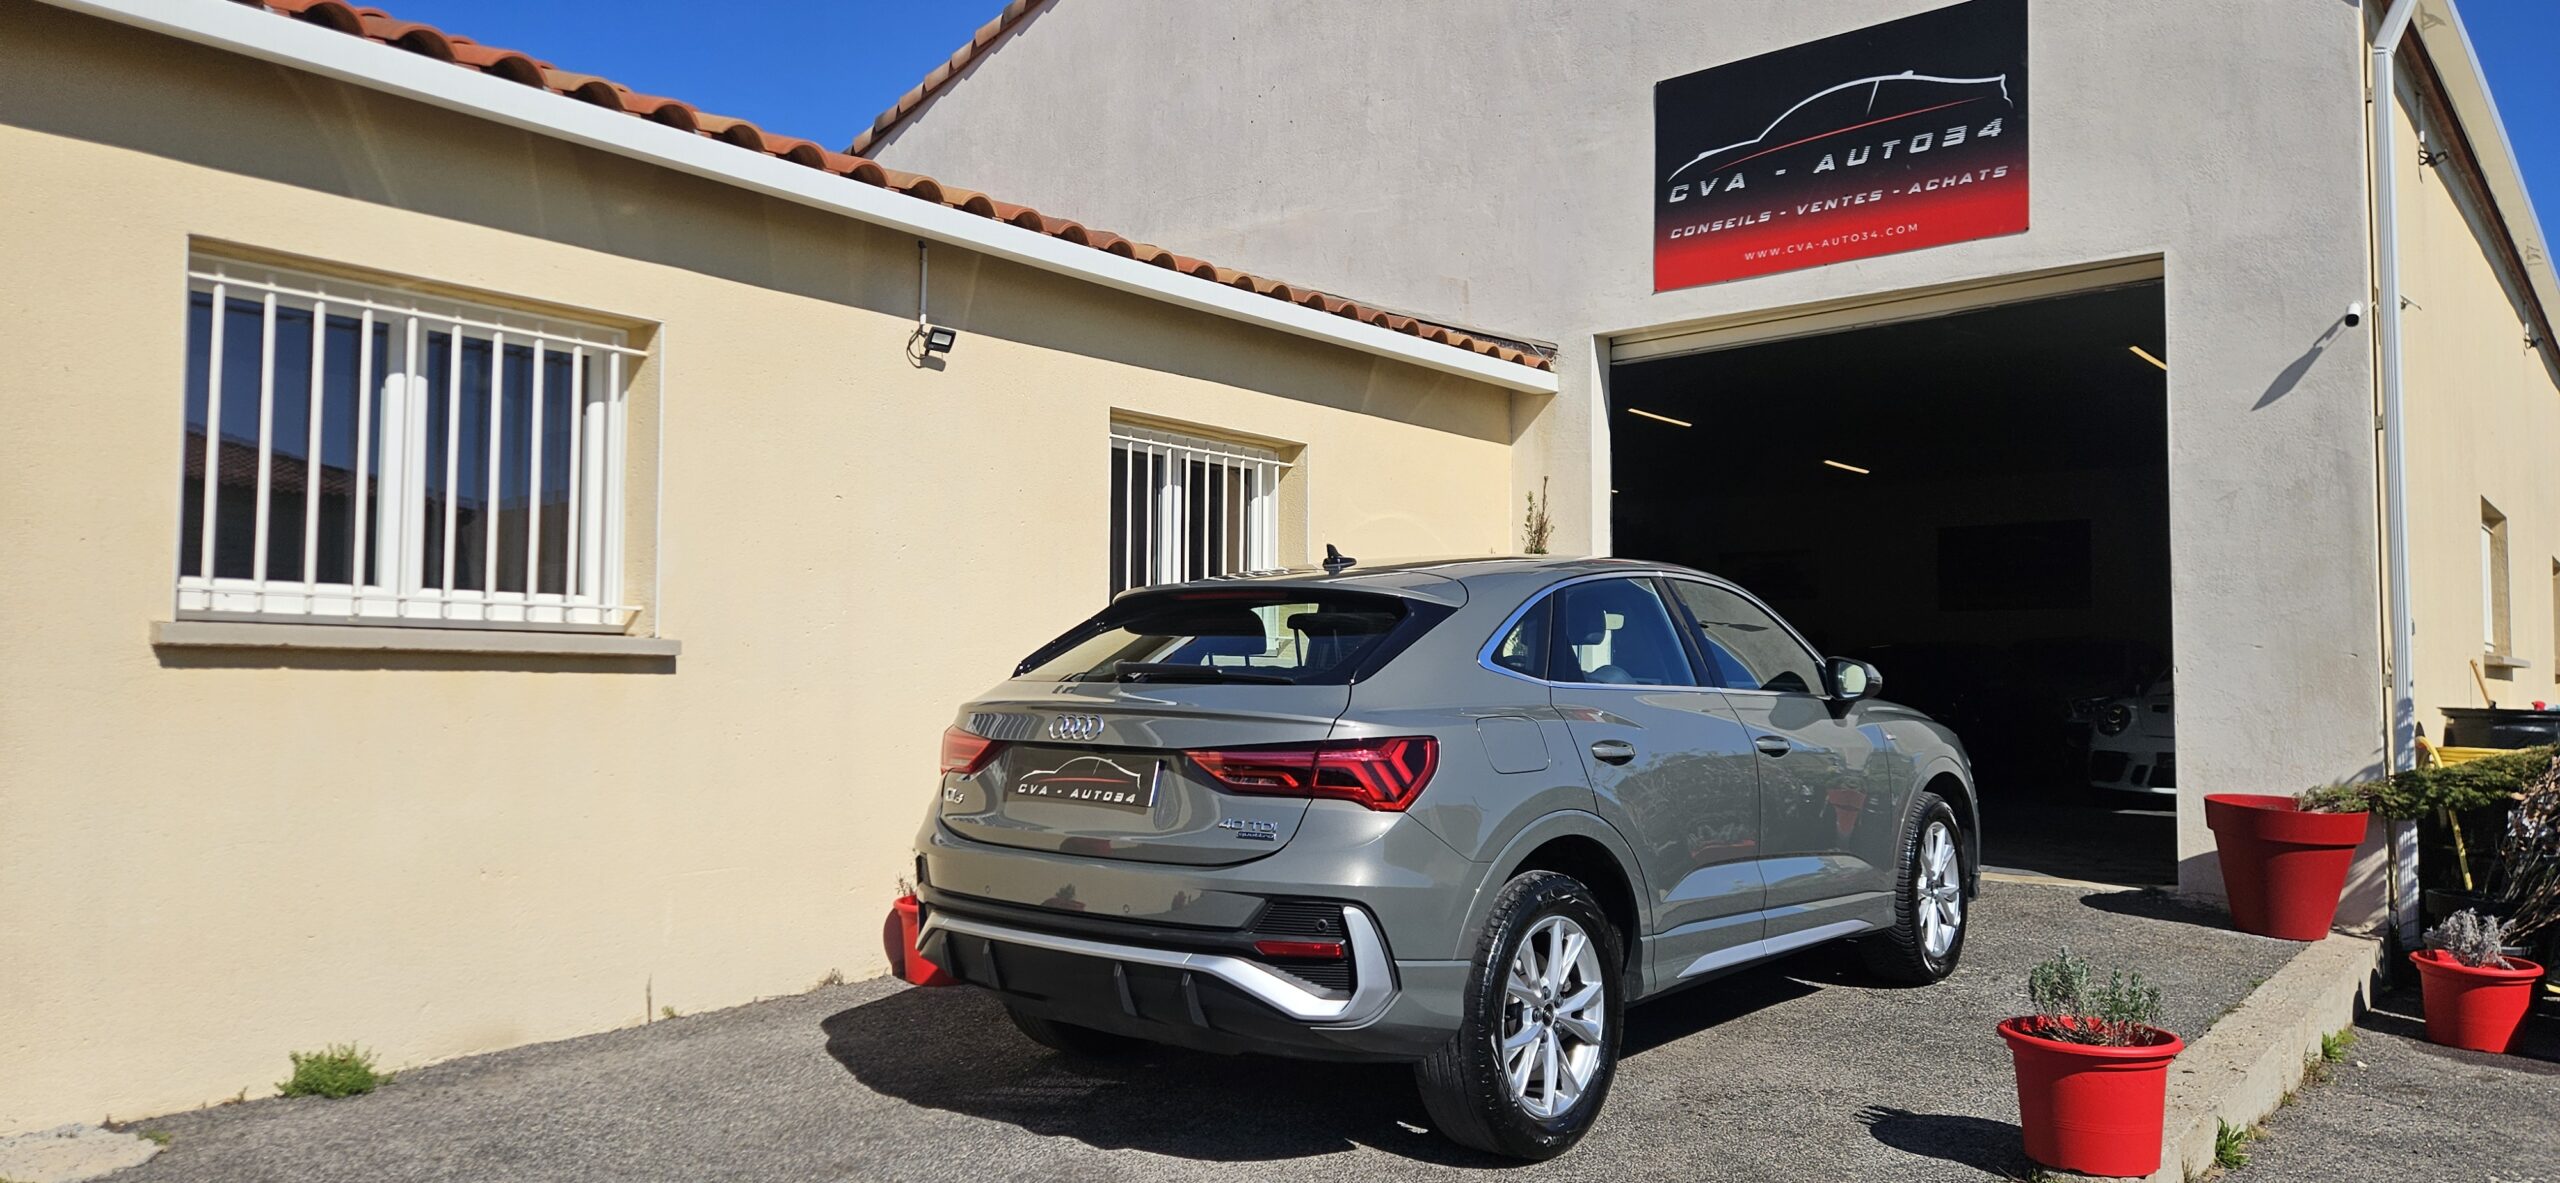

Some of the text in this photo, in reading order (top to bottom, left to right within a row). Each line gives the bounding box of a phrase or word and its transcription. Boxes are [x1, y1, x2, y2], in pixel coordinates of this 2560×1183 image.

[1668, 117, 2004, 203] CVA - AUTO34
[1669, 210, 1772, 239] CONSEILS
[1796, 189, 1884, 216] VENTES
[1907, 165, 2009, 195] ACHATS
[1744, 222, 1919, 260] WWW.CVA-AUTO34.COM
[1017, 783, 1049, 796] CVA
[1069, 787, 1137, 804] AUTO34
[1218, 818, 1279, 833] 40 TDI
